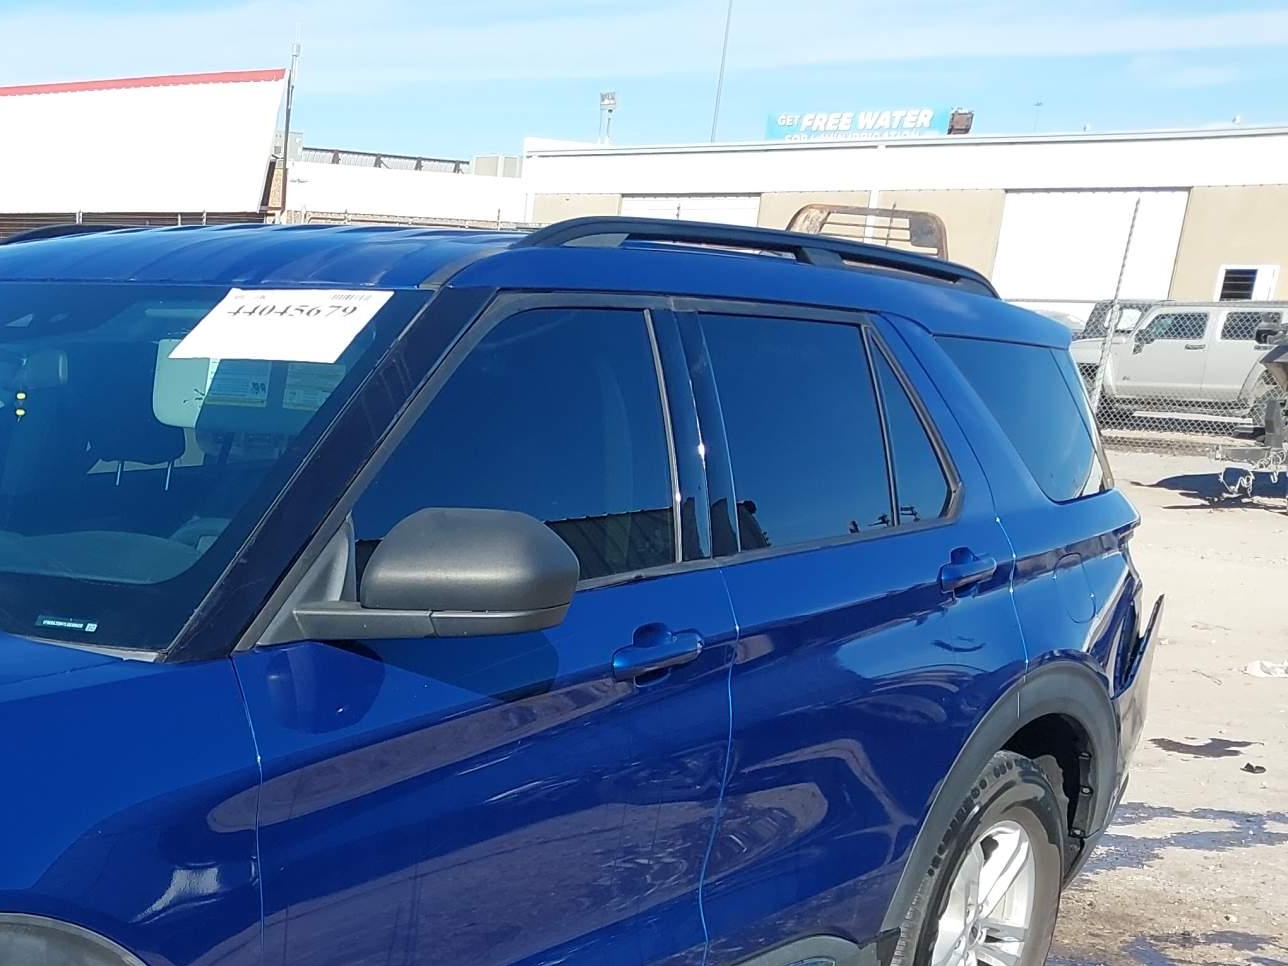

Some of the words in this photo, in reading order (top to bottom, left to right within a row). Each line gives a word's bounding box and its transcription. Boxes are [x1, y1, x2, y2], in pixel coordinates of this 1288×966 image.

[777, 112, 800, 126] GET
[800, 112, 853, 132] FREE
[858, 108, 934, 130] WATER
[227, 303, 358, 317] 44045679
